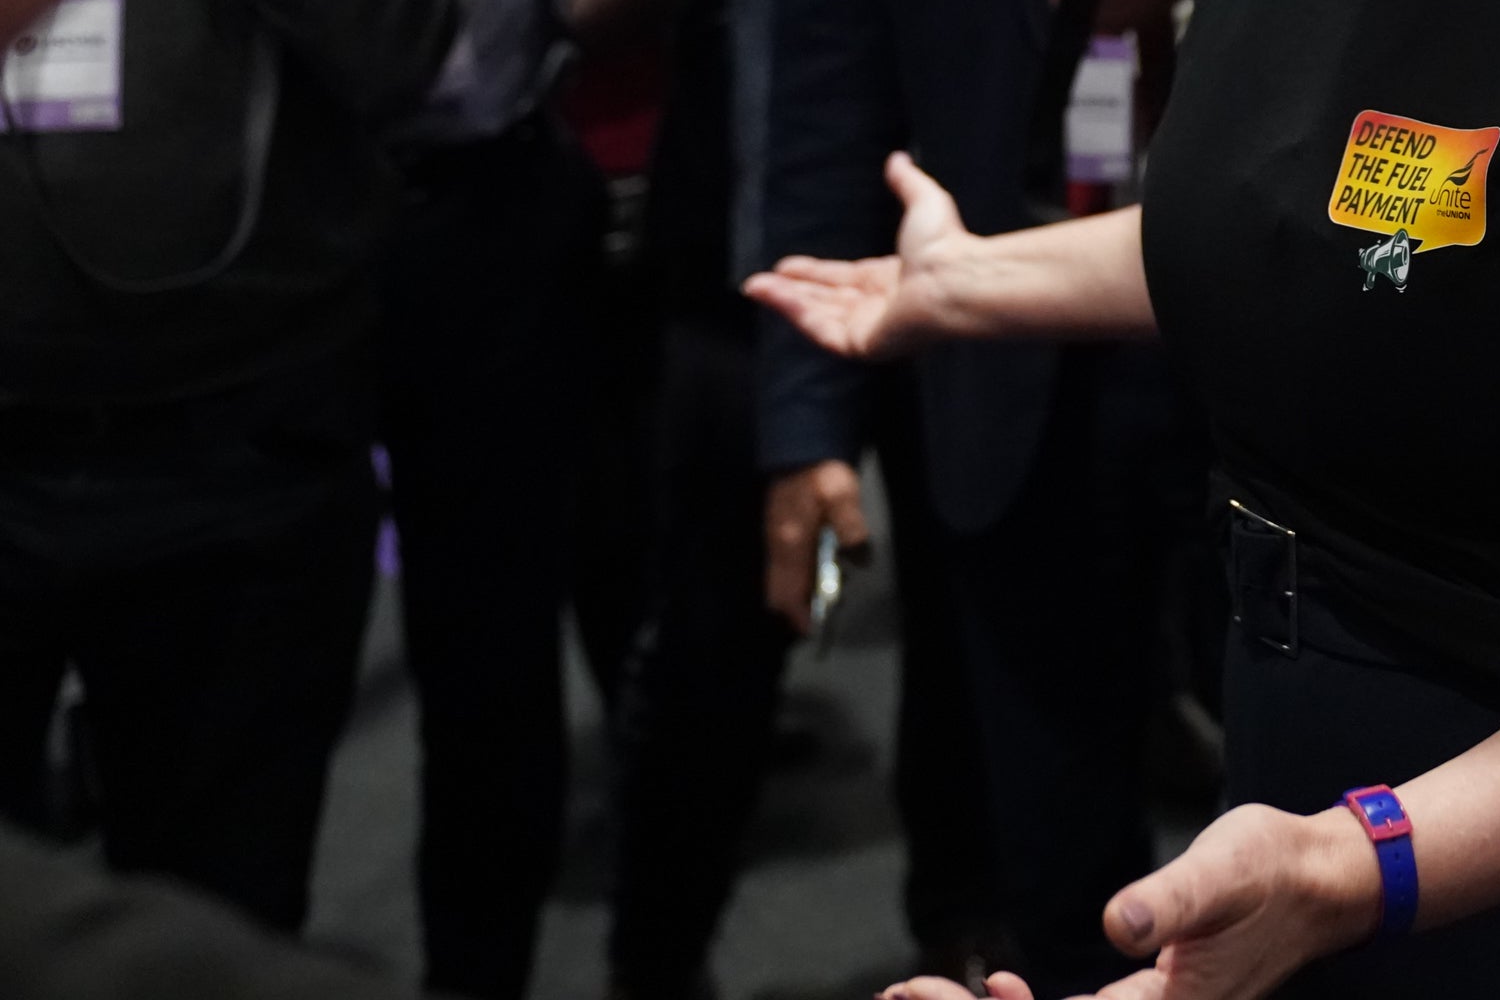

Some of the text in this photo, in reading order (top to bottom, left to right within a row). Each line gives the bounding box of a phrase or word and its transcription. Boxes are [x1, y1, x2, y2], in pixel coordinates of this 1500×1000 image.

[1355, 120, 1437, 160] DEFEND
[1348, 152, 1433, 191] THE FUEL
[1335, 185, 1425, 225] PAYMENT
[1429, 187, 1471, 209] unite
